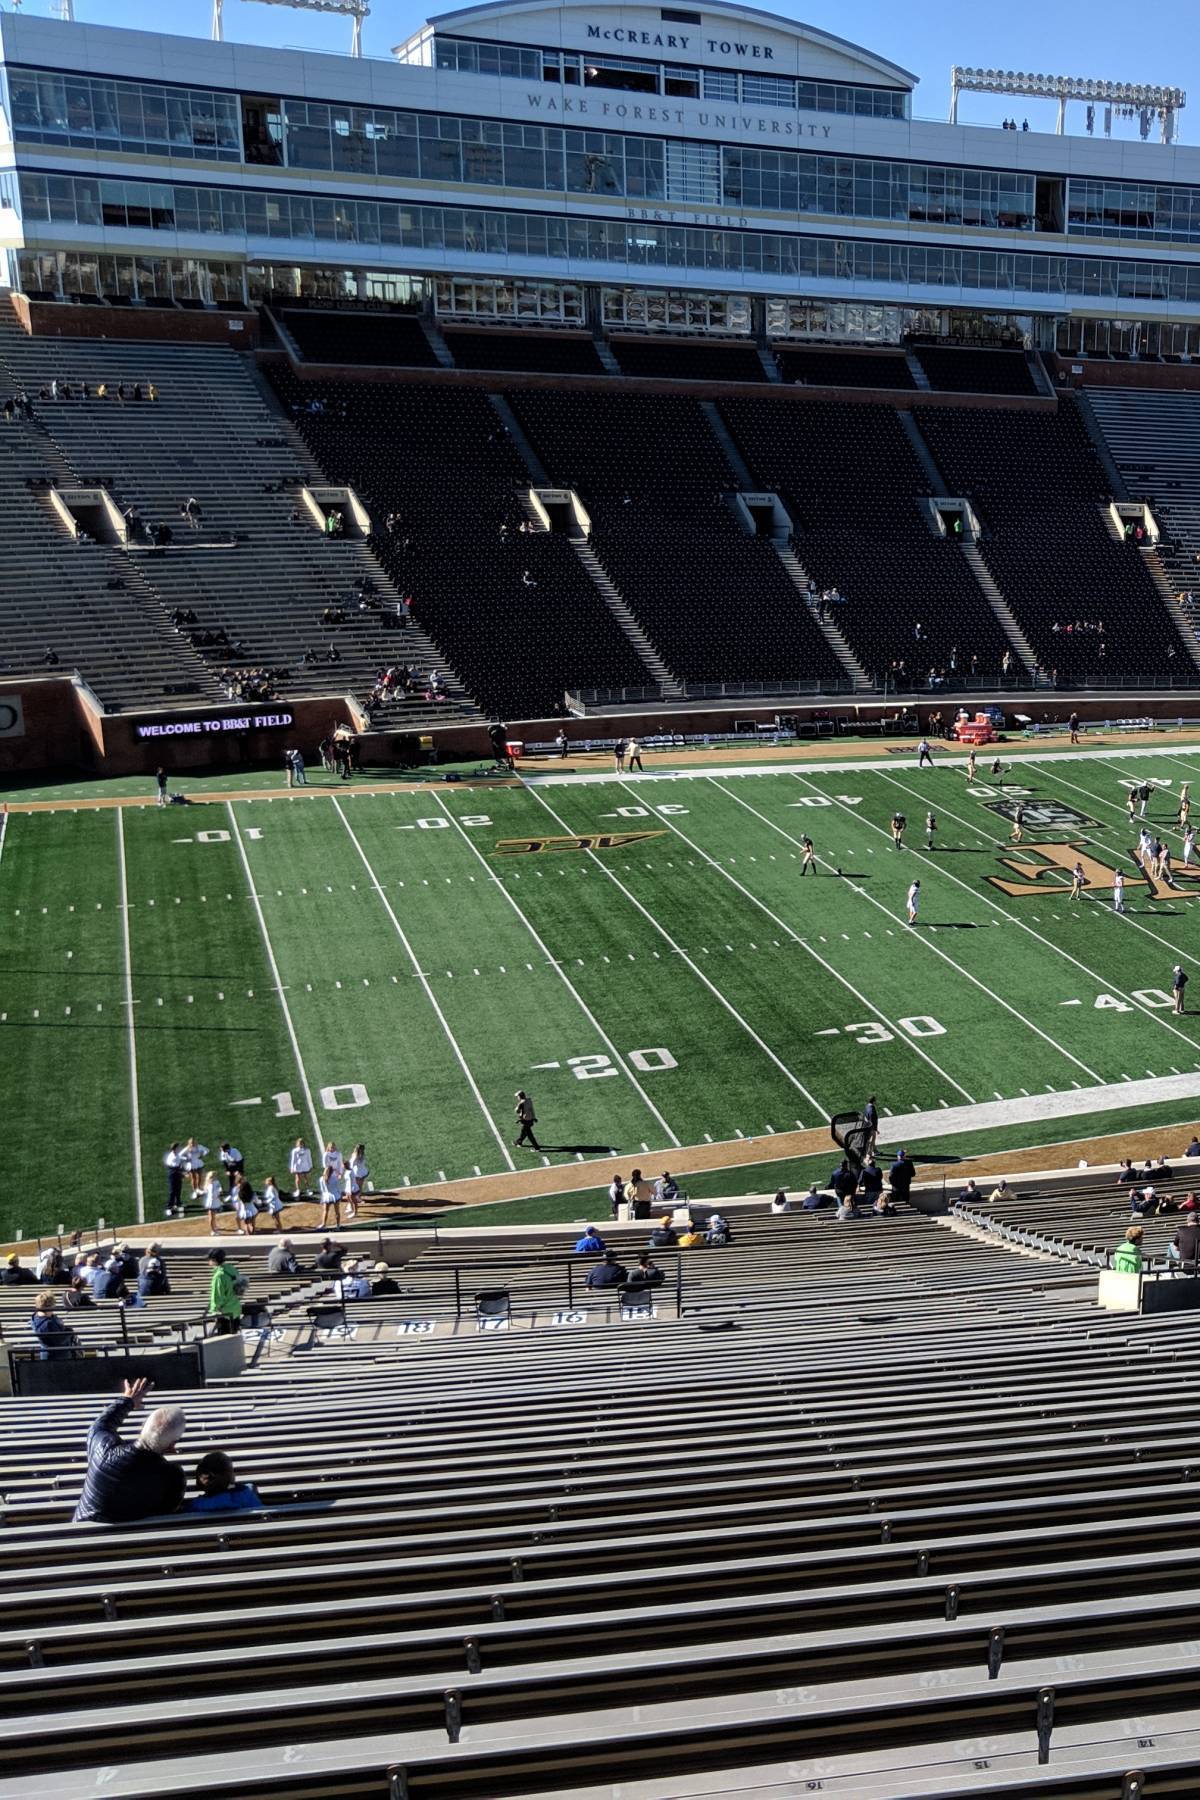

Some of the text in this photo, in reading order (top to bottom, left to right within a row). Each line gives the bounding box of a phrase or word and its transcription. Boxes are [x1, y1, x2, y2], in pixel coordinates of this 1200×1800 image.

[587, 25, 774, 60] McCREARY TOWER
[527, 94, 832, 138] WAKE FOREST UNIVERSITY
[627, 207, 749, 228] BB&T FIELD
[139, 714, 293, 738] WELCOME TO BB&T FIELD
[1094, 988, 1176, 1013] 40
[844, 1015, 948, 1044] 30
[566, 1047, 678, 1079] 20
[272, 1083, 371, 1117] 10
[403, 1321, 429, 1333] 18
[556, 1312, 582, 1323] 16
